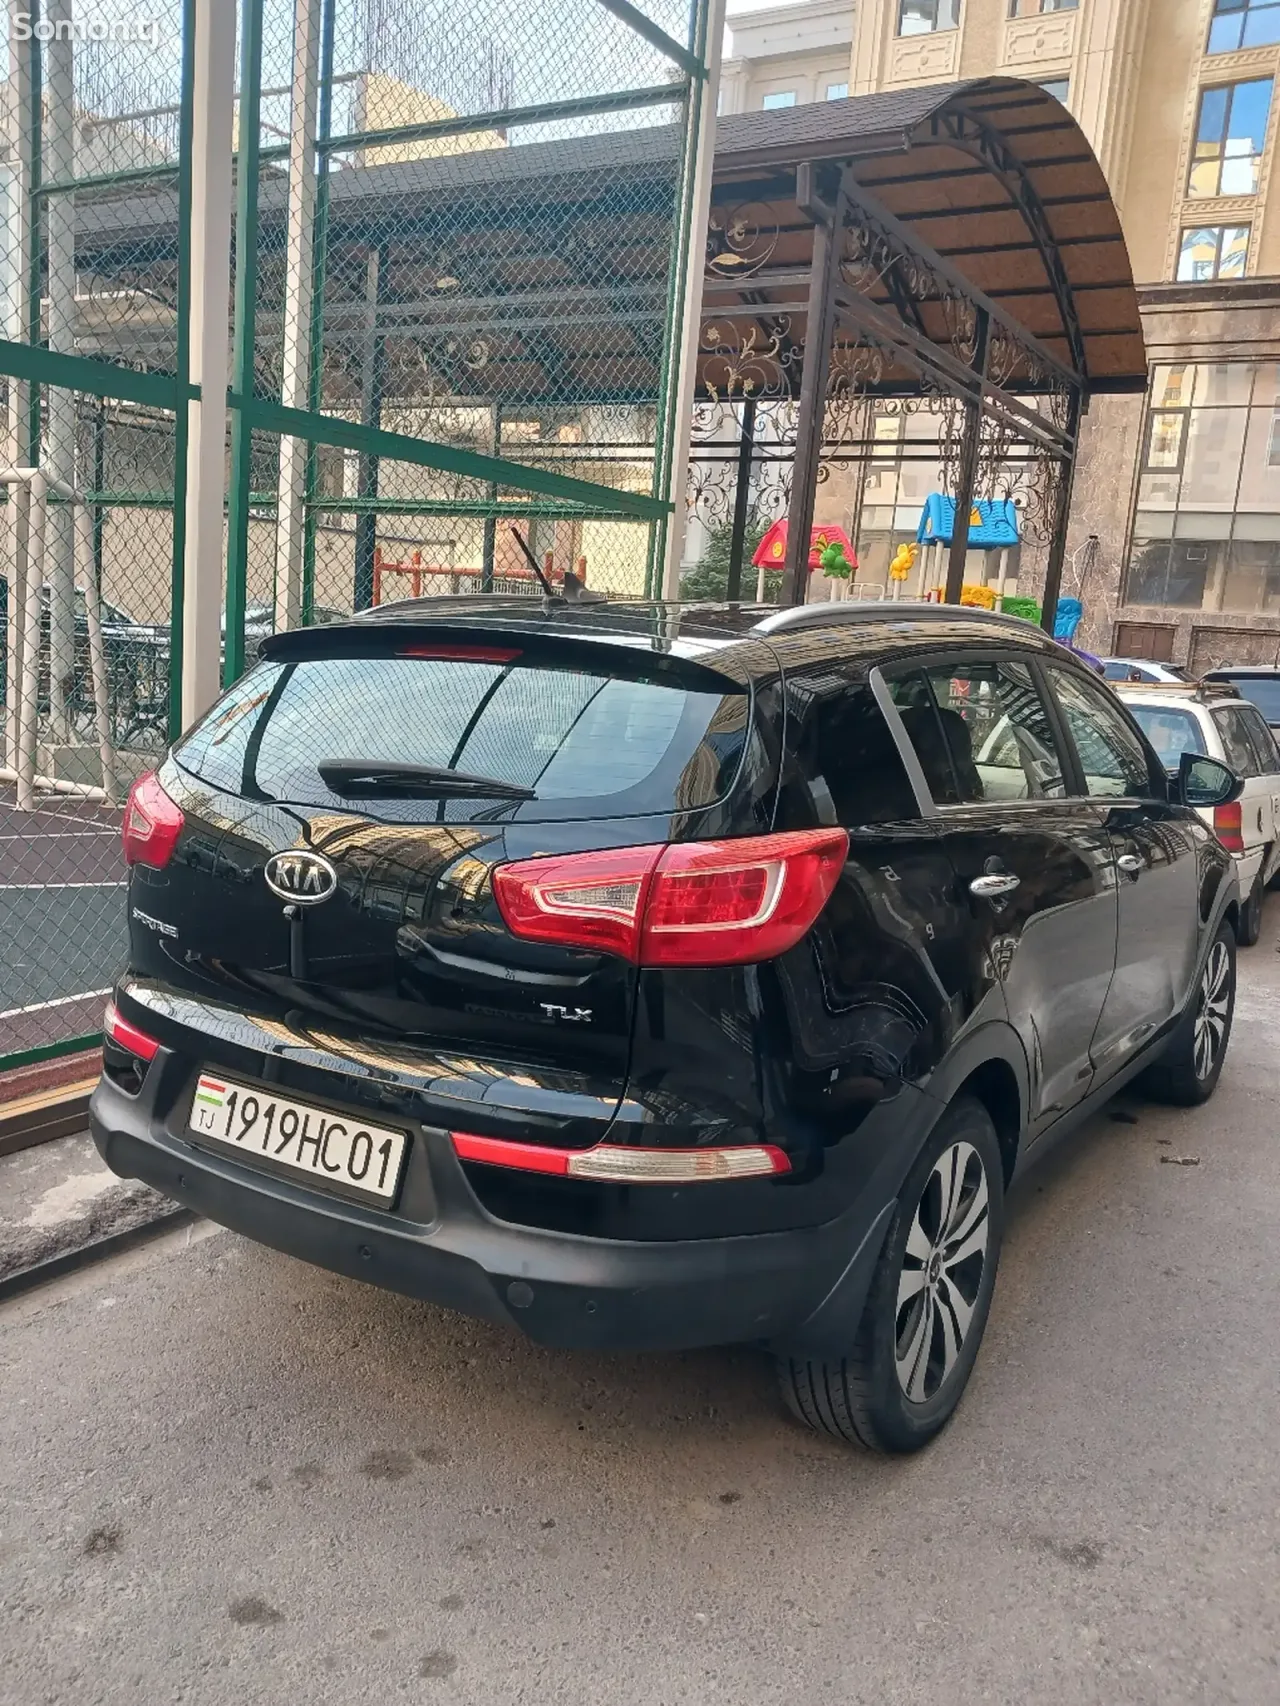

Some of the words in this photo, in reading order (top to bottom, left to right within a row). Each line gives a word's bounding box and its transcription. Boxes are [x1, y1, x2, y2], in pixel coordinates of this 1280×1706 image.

[274, 859, 322, 893] KIA
[539, 1003, 593, 1022] TLX
[198, 1108, 216, 1130] TJ
[224, 1090, 393, 1189] 1919HC01
